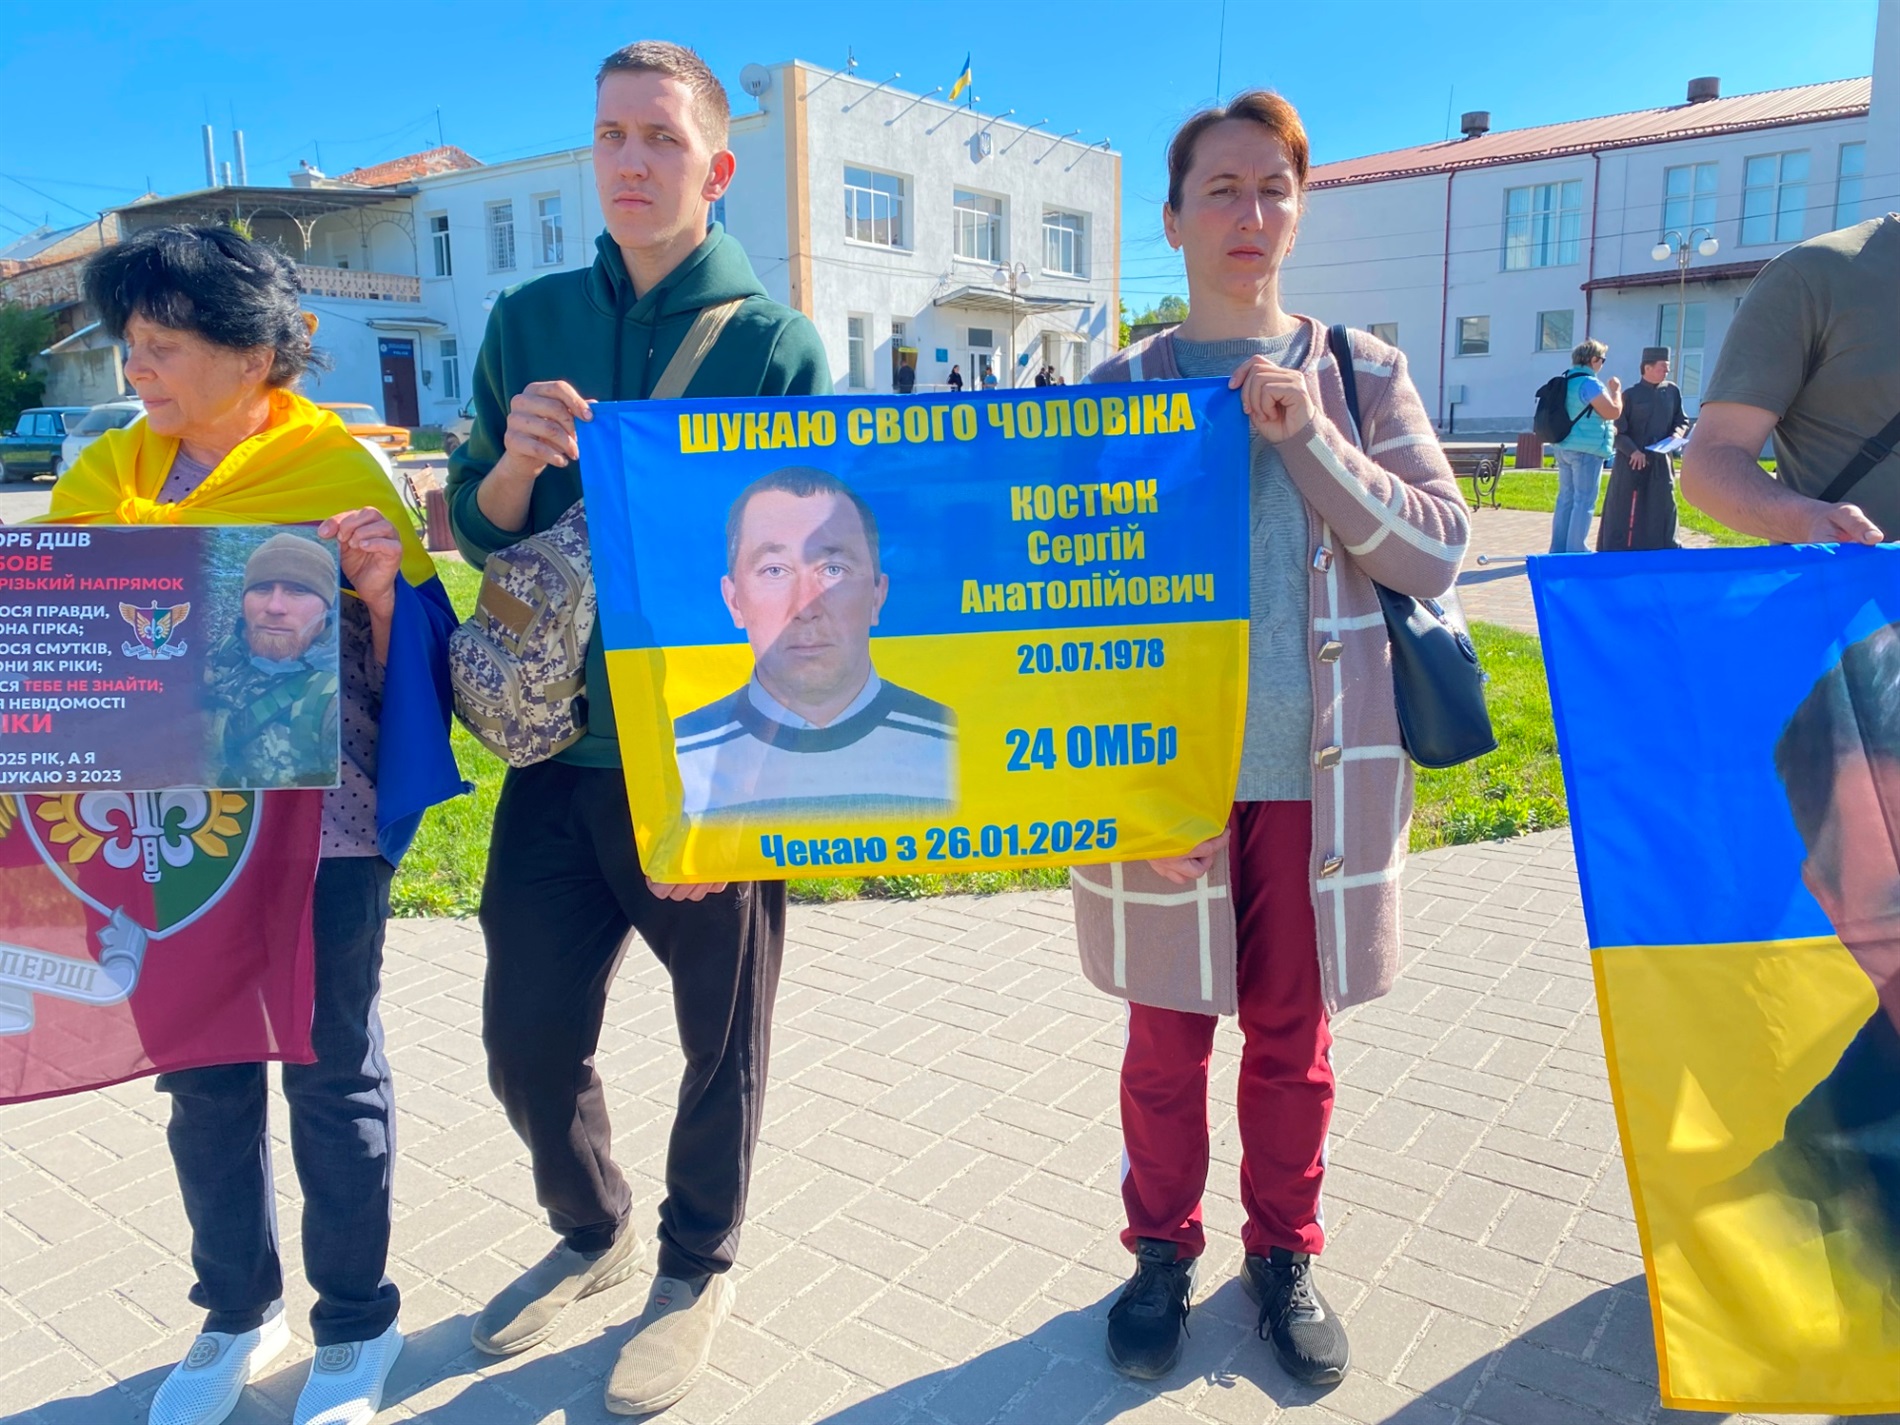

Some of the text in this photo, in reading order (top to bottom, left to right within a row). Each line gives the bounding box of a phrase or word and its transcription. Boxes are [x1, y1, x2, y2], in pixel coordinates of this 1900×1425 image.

[679, 393, 1195, 453] ШУКАЮ СВОГО ЧОЛОВІКА
[1010, 479, 1158, 521] КОСТЮК
[36, 532, 91, 551] ДШВ
[1027, 524, 1145, 566] Сергій
[80, 577, 184, 590] НАПРЯМОК
[960, 573, 1215, 614] Анатолійович
[36, 605, 110, 620] ПРАВДИ,
[32, 623, 84, 637] ГІРКА;
[35, 642, 113, 657] СМУТКІВ,
[1017, 637, 1166, 675] 20.07.1978
[32, 660, 55, 672] ЯК
[58, 660, 103, 674] РІКИ;
[23, 680, 63, 692] ТЕБЕ
[66, 680, 88, 692] НЕ
[92, 675, 164, 692] ЗНАЙТИ;
[9, 697, 126, 712] НЕВІДОМОСТІ
[1004, 722, 1178, 772] 24 ОМБр
[31, 752, 65, 767] РІК,
[68, 752, 81, 765] А
[84, 752, 96, 764] Я
[80, 769, 122, 783] 2023
[759, 818, 1118, 868] Чекаю з 26.01.2025
[0, 950, 98, 993] ПЕРШІ
